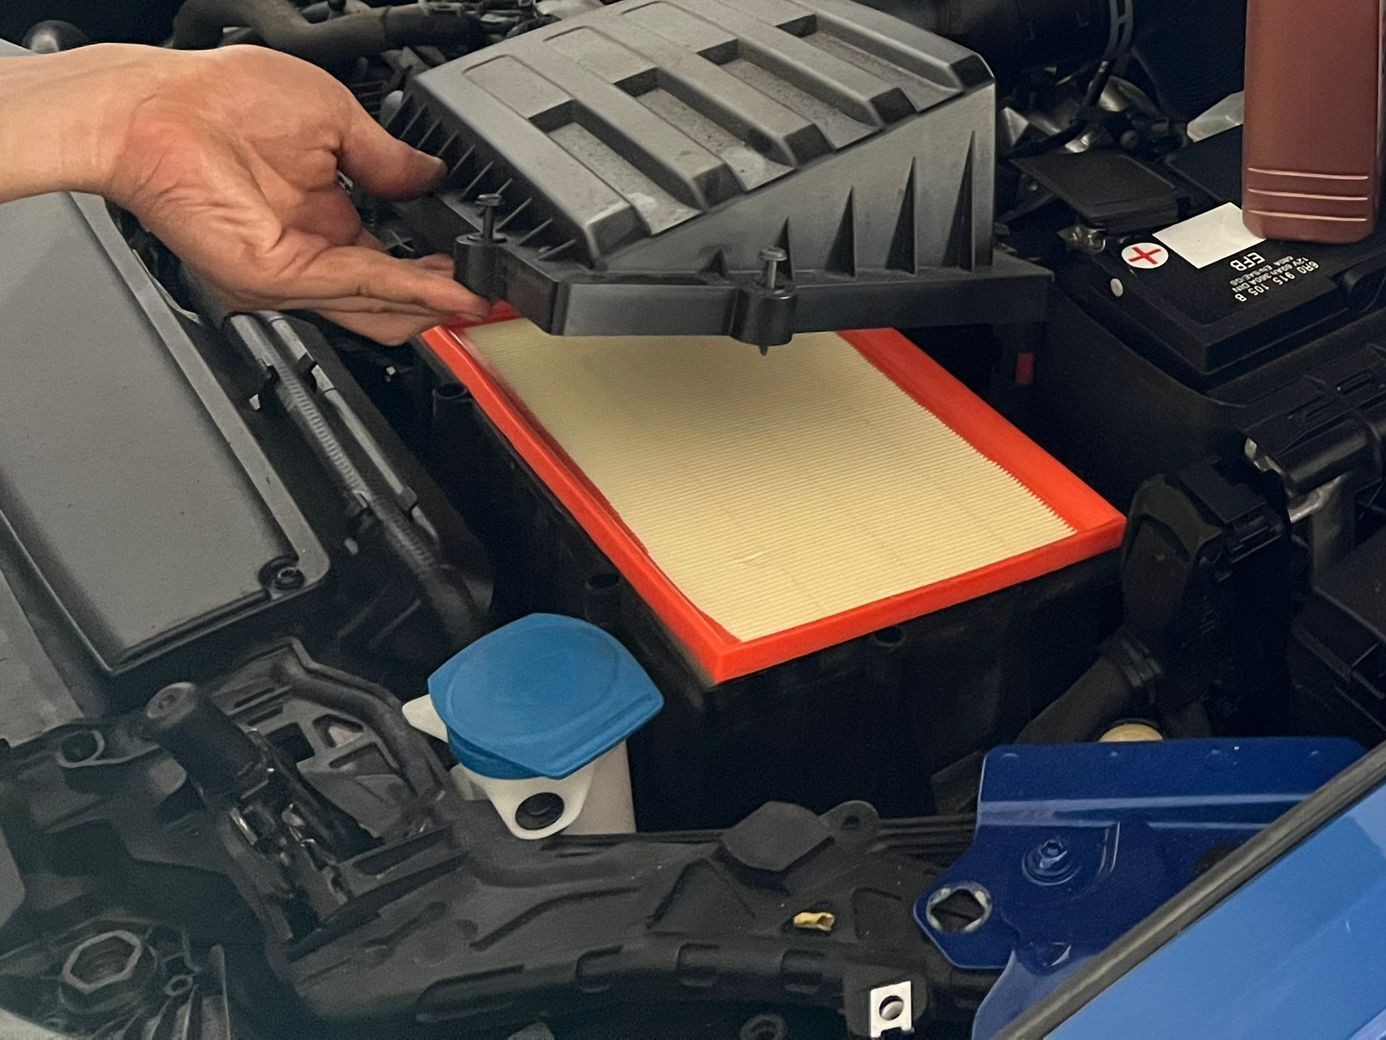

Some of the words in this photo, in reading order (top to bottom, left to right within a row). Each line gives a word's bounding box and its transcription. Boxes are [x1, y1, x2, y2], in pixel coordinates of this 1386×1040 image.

[1230, 252, 1266, 271] EFB
[1292, 257, 1309, 267] 12V
[1296, 260, 1319, 274] 6R0
[1272, 271, 1295, 285] 915
[1248, 283, 1269, 296] 105
[1234, 293, 1247, 302] B
